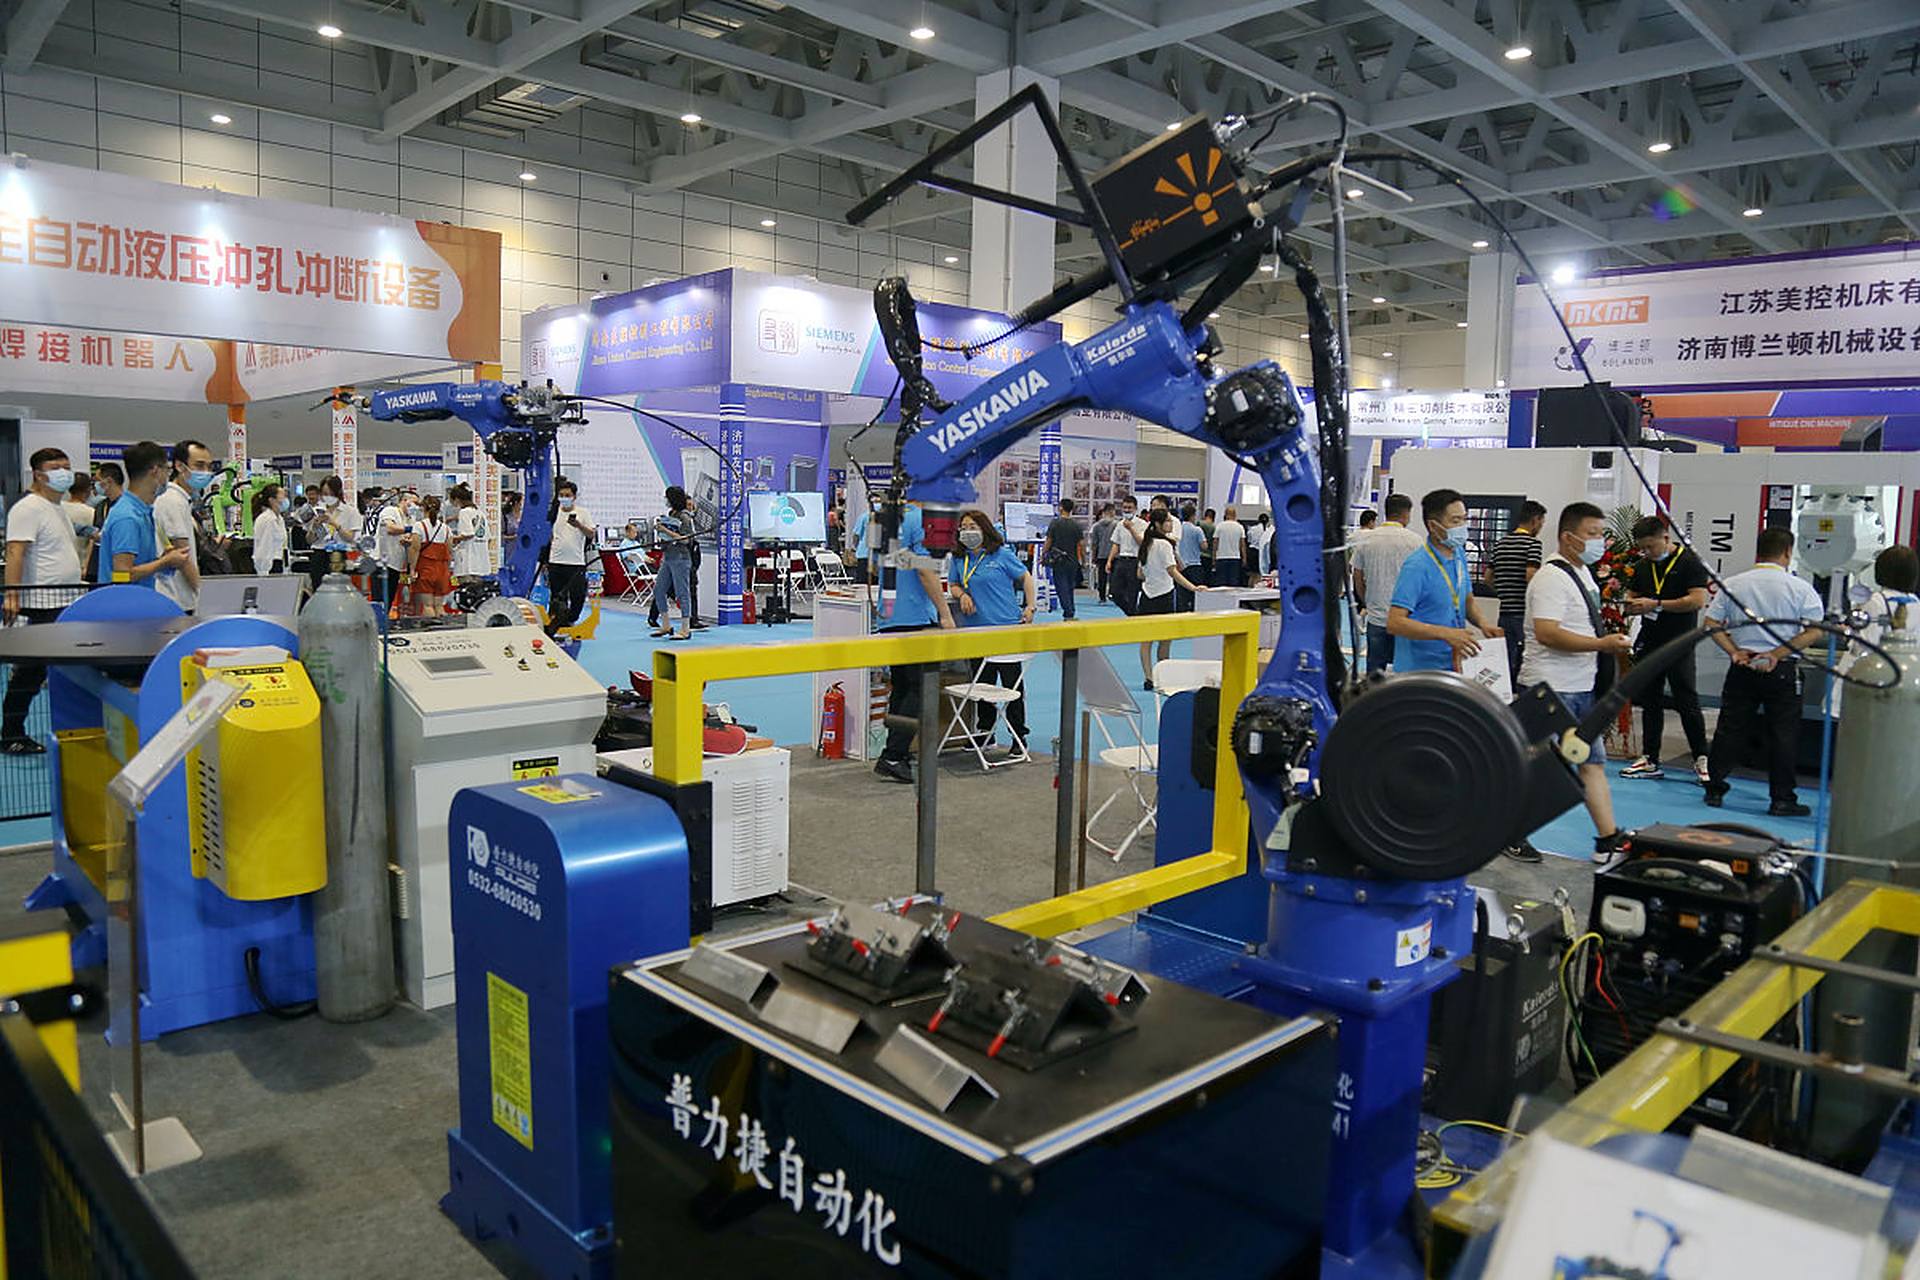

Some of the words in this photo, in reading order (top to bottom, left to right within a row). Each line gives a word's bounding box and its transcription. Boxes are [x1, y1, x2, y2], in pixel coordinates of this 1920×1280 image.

[1720, 278, 1920, 316] 江苏美控机床有
[0, 328, 193, 372] 焊接机器人
[805, 326, 856, 344] SIEMENS
[385, 390, 437, 409] YASKAWA
[928, 369, 1050, 453] YASKAWA
[665, 1072, 901, 1266] 普力捷自动化
